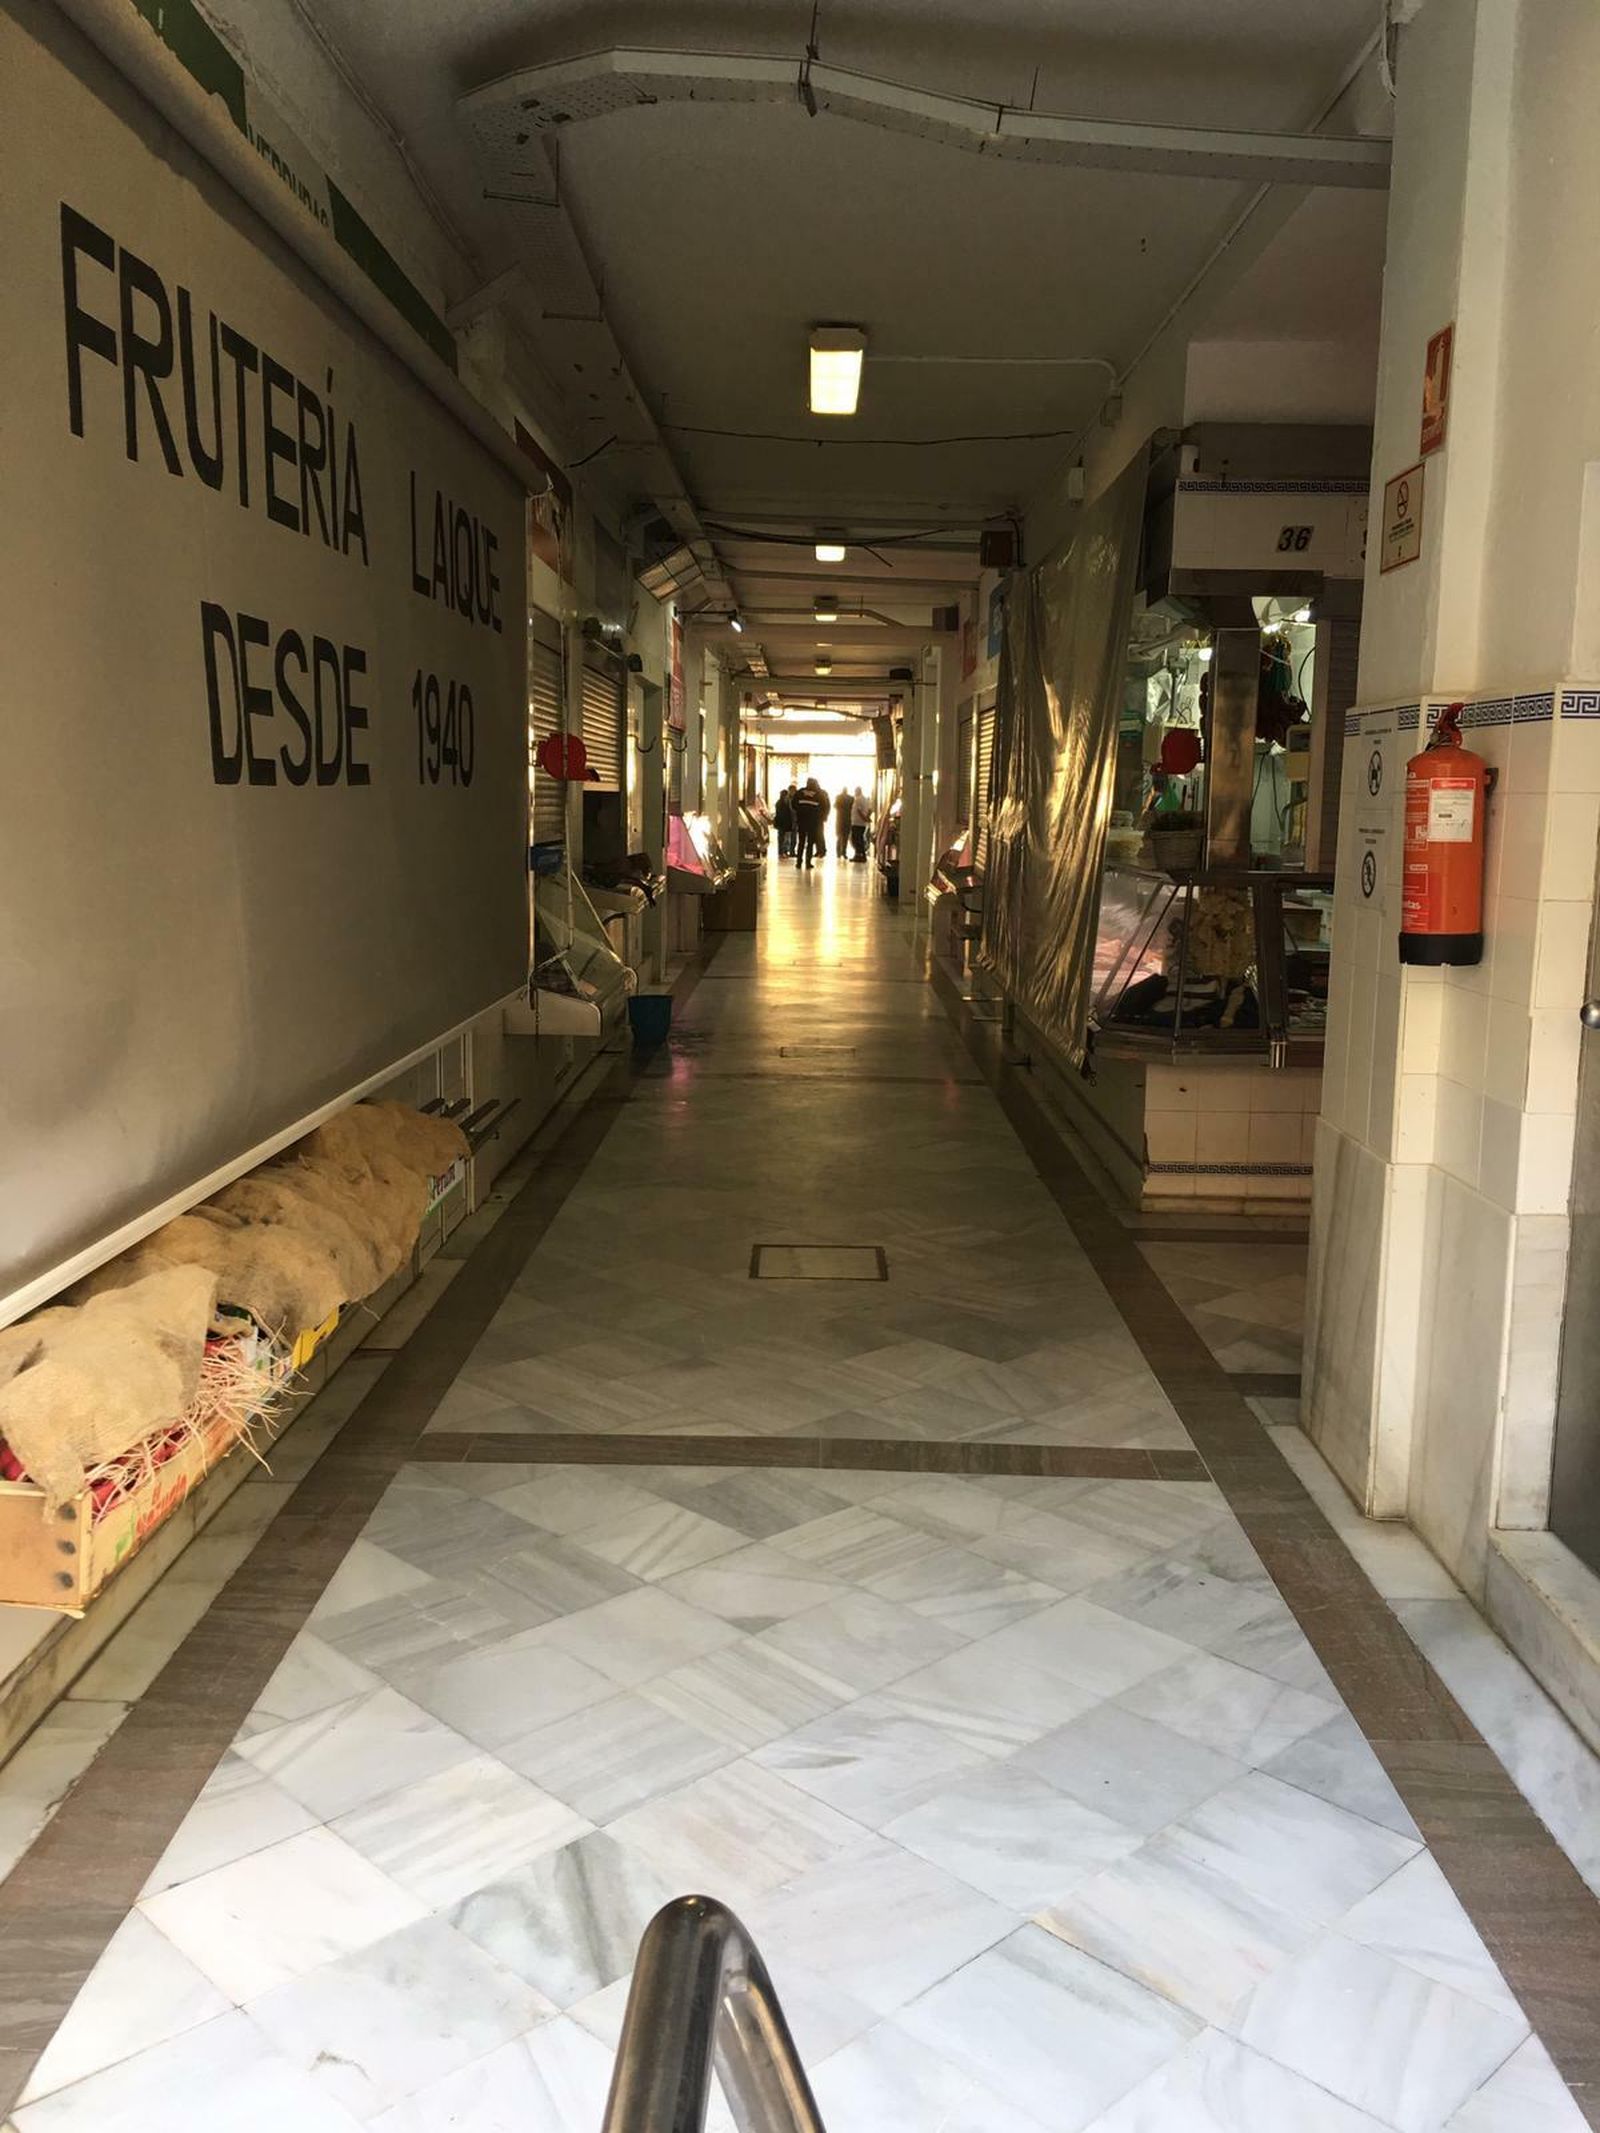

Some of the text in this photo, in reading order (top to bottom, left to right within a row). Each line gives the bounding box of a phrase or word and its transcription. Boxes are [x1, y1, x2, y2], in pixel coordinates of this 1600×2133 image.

[61, 202, 502, 634] FRUTERÍA LAIQUE
[1278, 526, 1312, 552] 36
[201, 600, 474, 788] DESDE 1940
